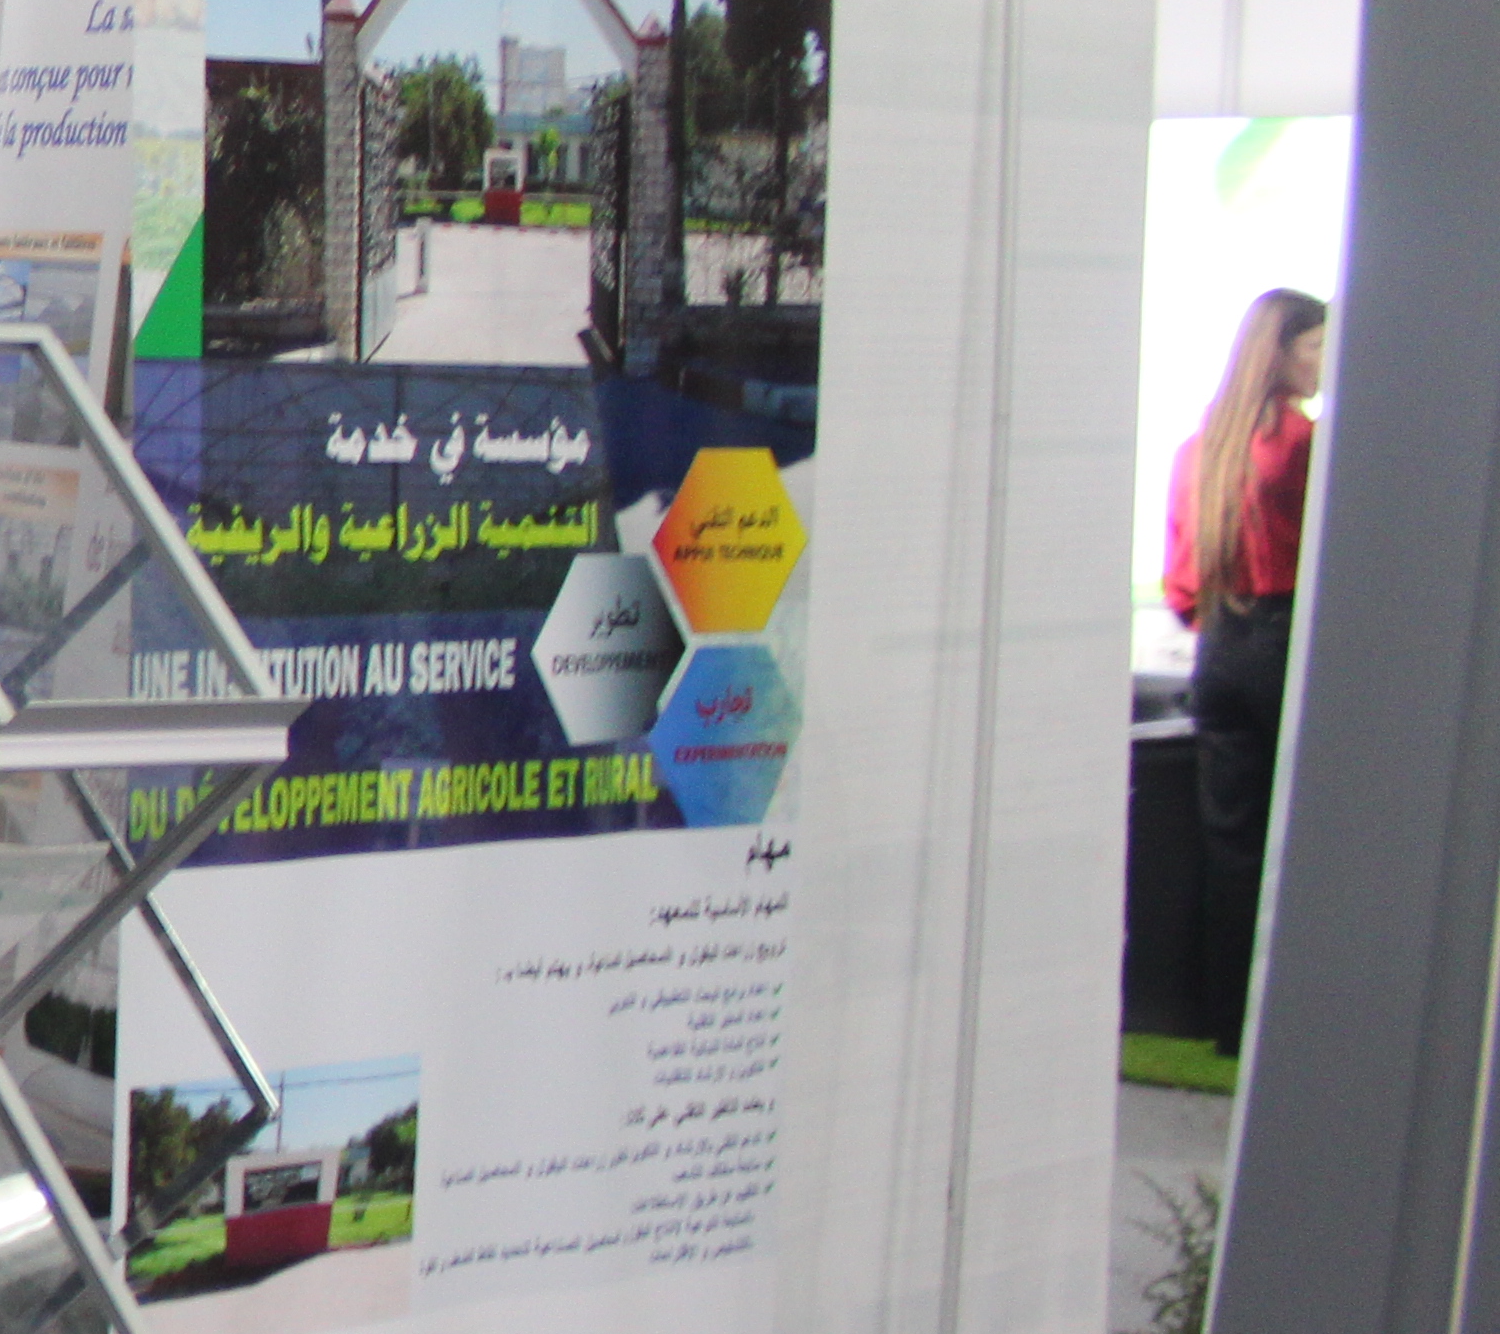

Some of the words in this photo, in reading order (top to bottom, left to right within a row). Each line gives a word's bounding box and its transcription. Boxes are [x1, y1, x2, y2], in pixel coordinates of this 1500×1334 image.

[11, 65, 71, 101] conçue
[73, 63, 124, 102] pour
[18, 107, 129, 159] production
[325, 410, 418, 464] خدمة
[428, 411, 465, 485] في
[474, 413, 589, 473] مؤسسة
[187, 502, 330, 565] والريفية
[339, 500, 469, 561] الزراعية
[478, 499, 598, 557] التنمية
[130, 650, 189, 700] UNE
[364, 645, 400, 694] AU
[410, 639, 516, 693] SERVICE
[695, 685, 754, 727] تجارب
[129, 789, 168, 842] DU
[416, 760, 541, 819] AGRICOLE
[546, 758, 578, 807] ET
[585, 752, 658, 803] RURAL
